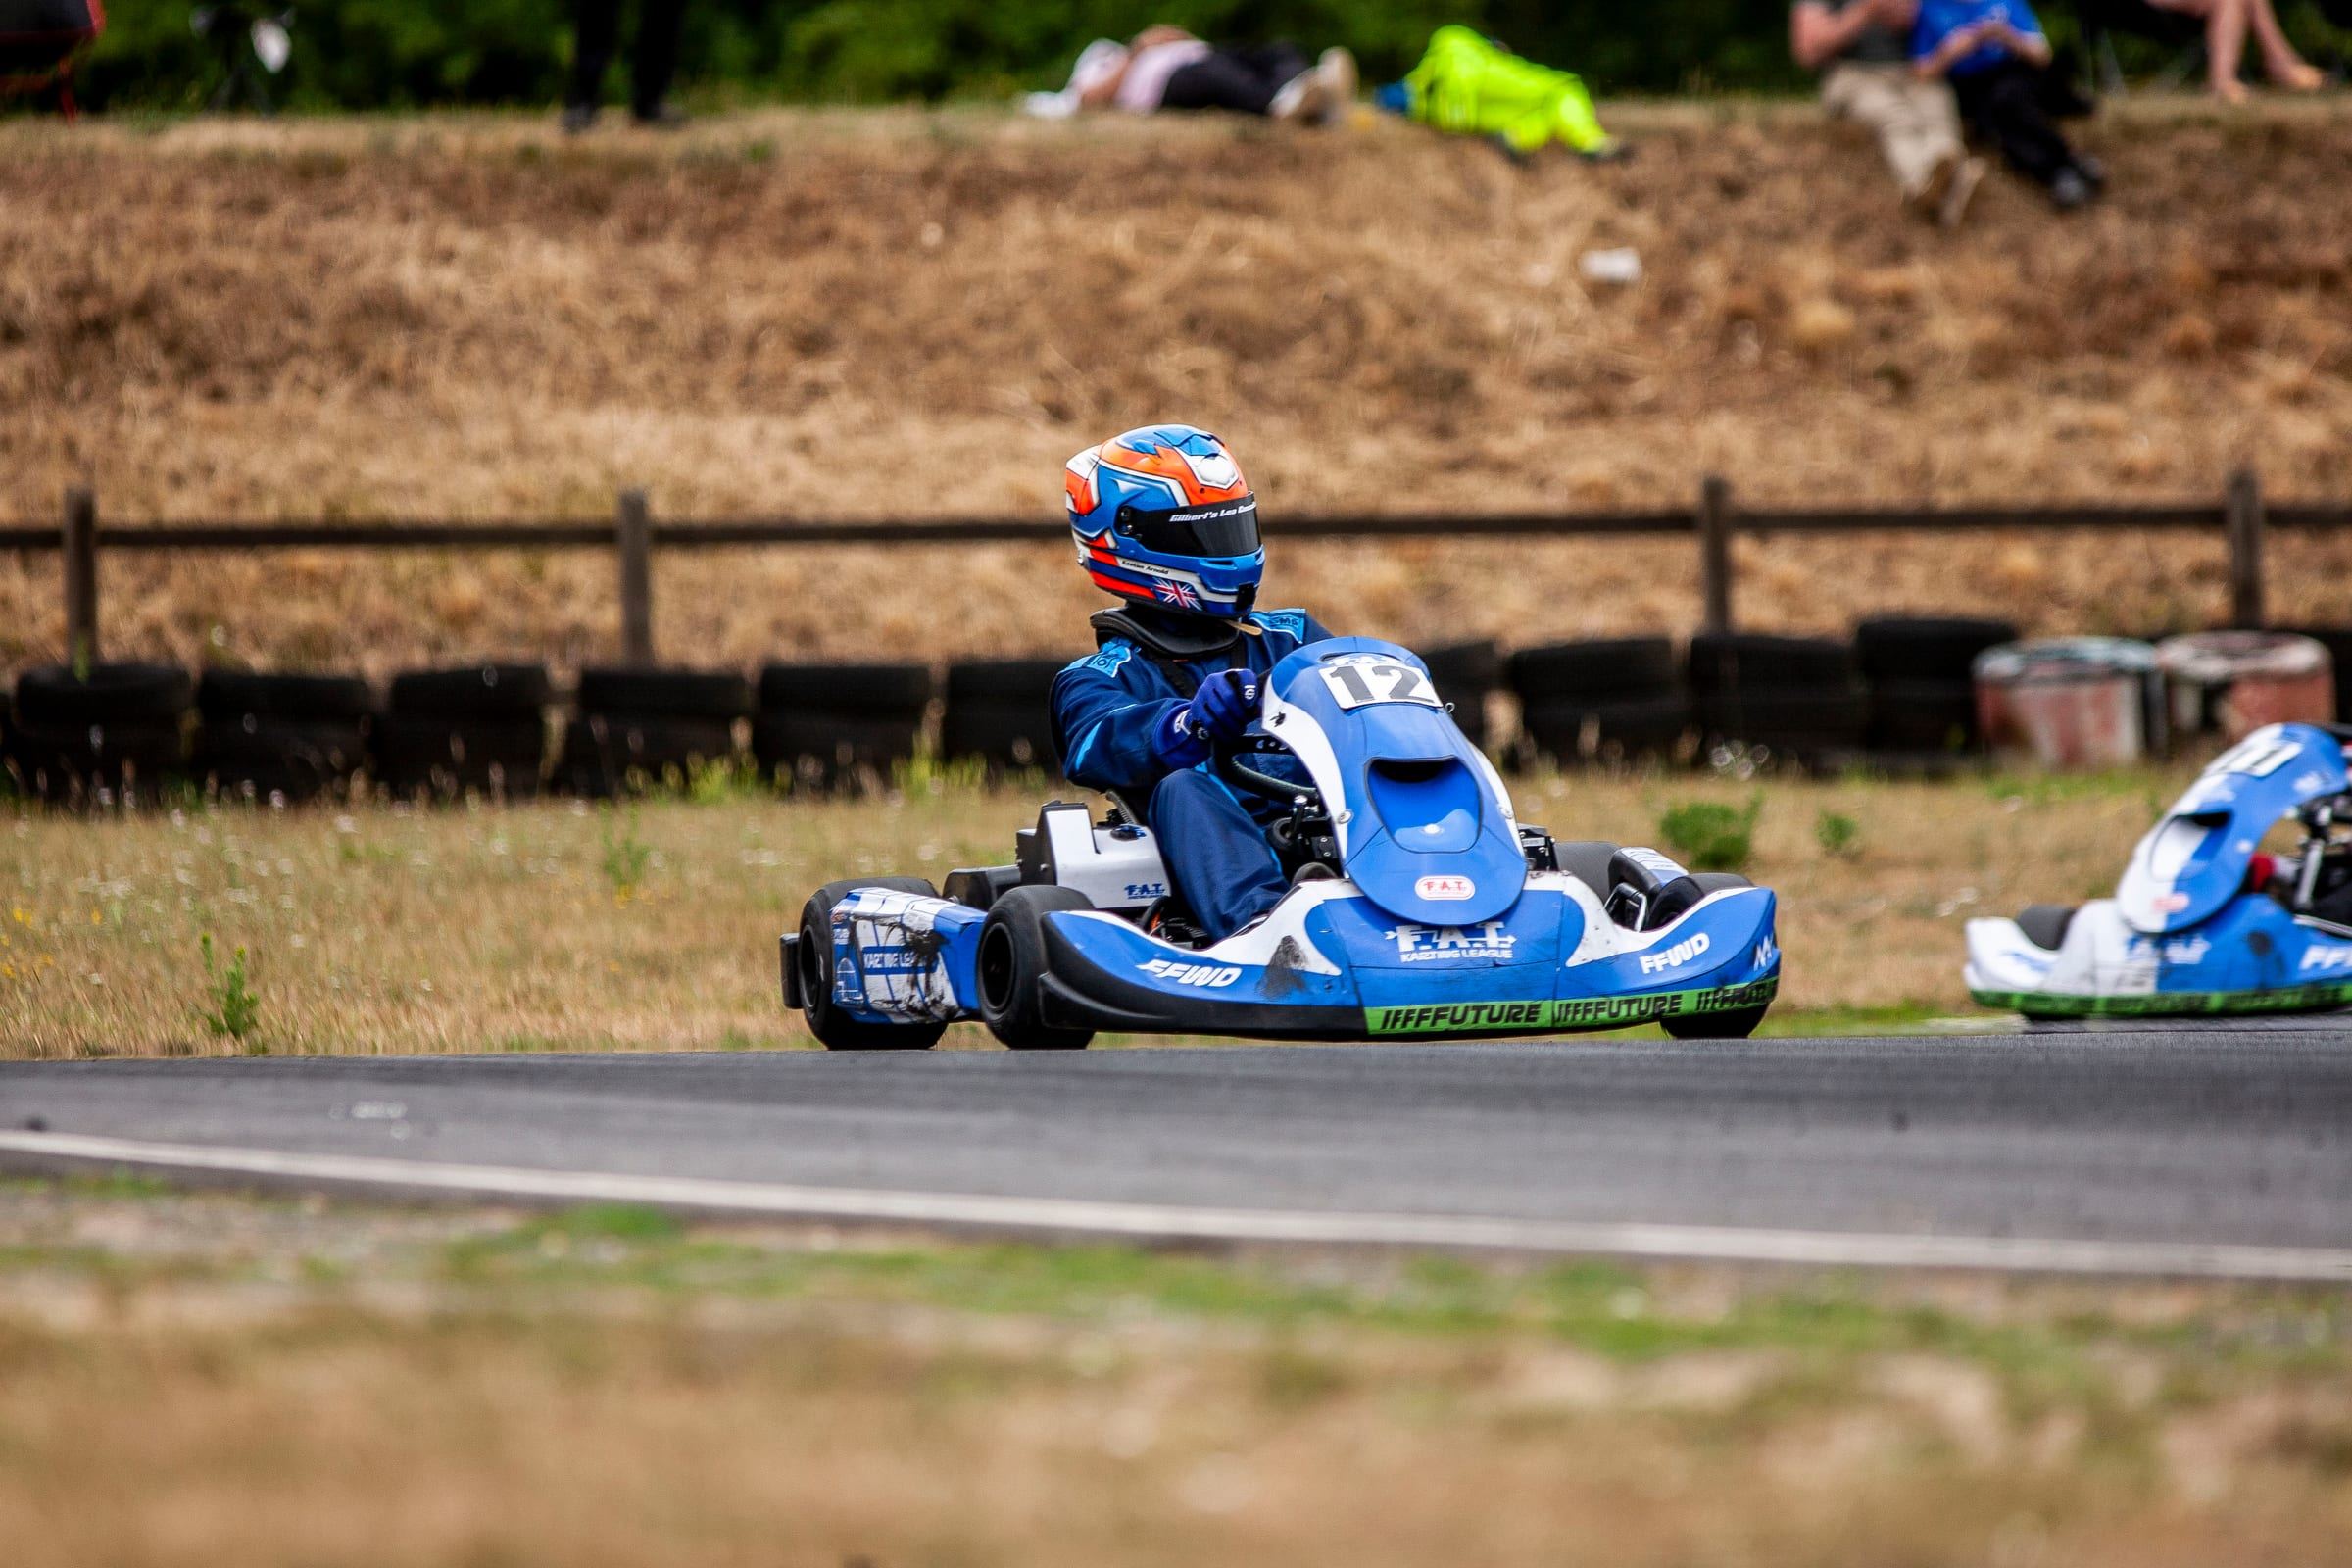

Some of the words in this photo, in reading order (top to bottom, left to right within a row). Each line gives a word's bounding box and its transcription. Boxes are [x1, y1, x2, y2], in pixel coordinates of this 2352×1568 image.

[1330, 665, 1434, 704] 12
[1461, 948, 1513, 959] LEAGUE
[1640, 933, 1710, 974] FFWD
[1135, 958, 1243, 987] FFWD
